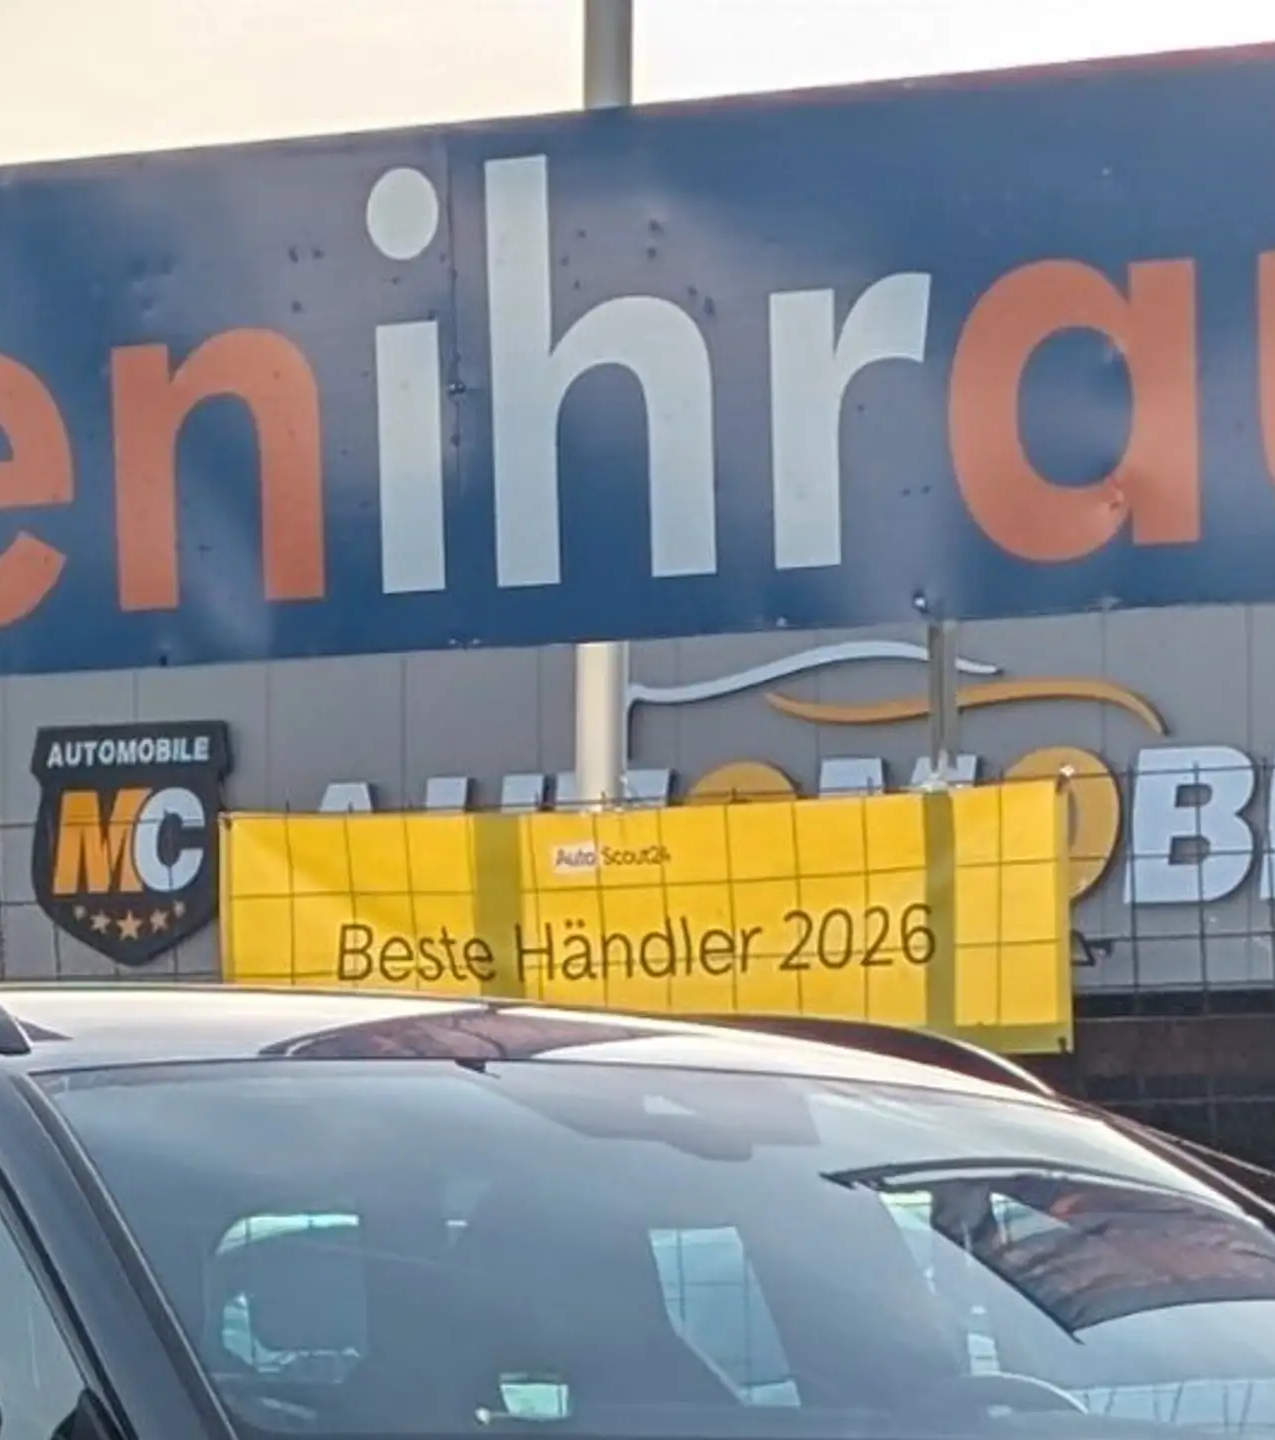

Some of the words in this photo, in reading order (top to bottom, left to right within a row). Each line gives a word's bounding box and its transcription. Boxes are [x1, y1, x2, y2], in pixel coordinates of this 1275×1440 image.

[47, 736, 210, 768] AUTOMOBILE
[53, 786, 206, 895] MC
[337, 922, 496, 982] Beste
[515, 916, 763, 982] Händler
[779, 903, 937, 971] 2026
